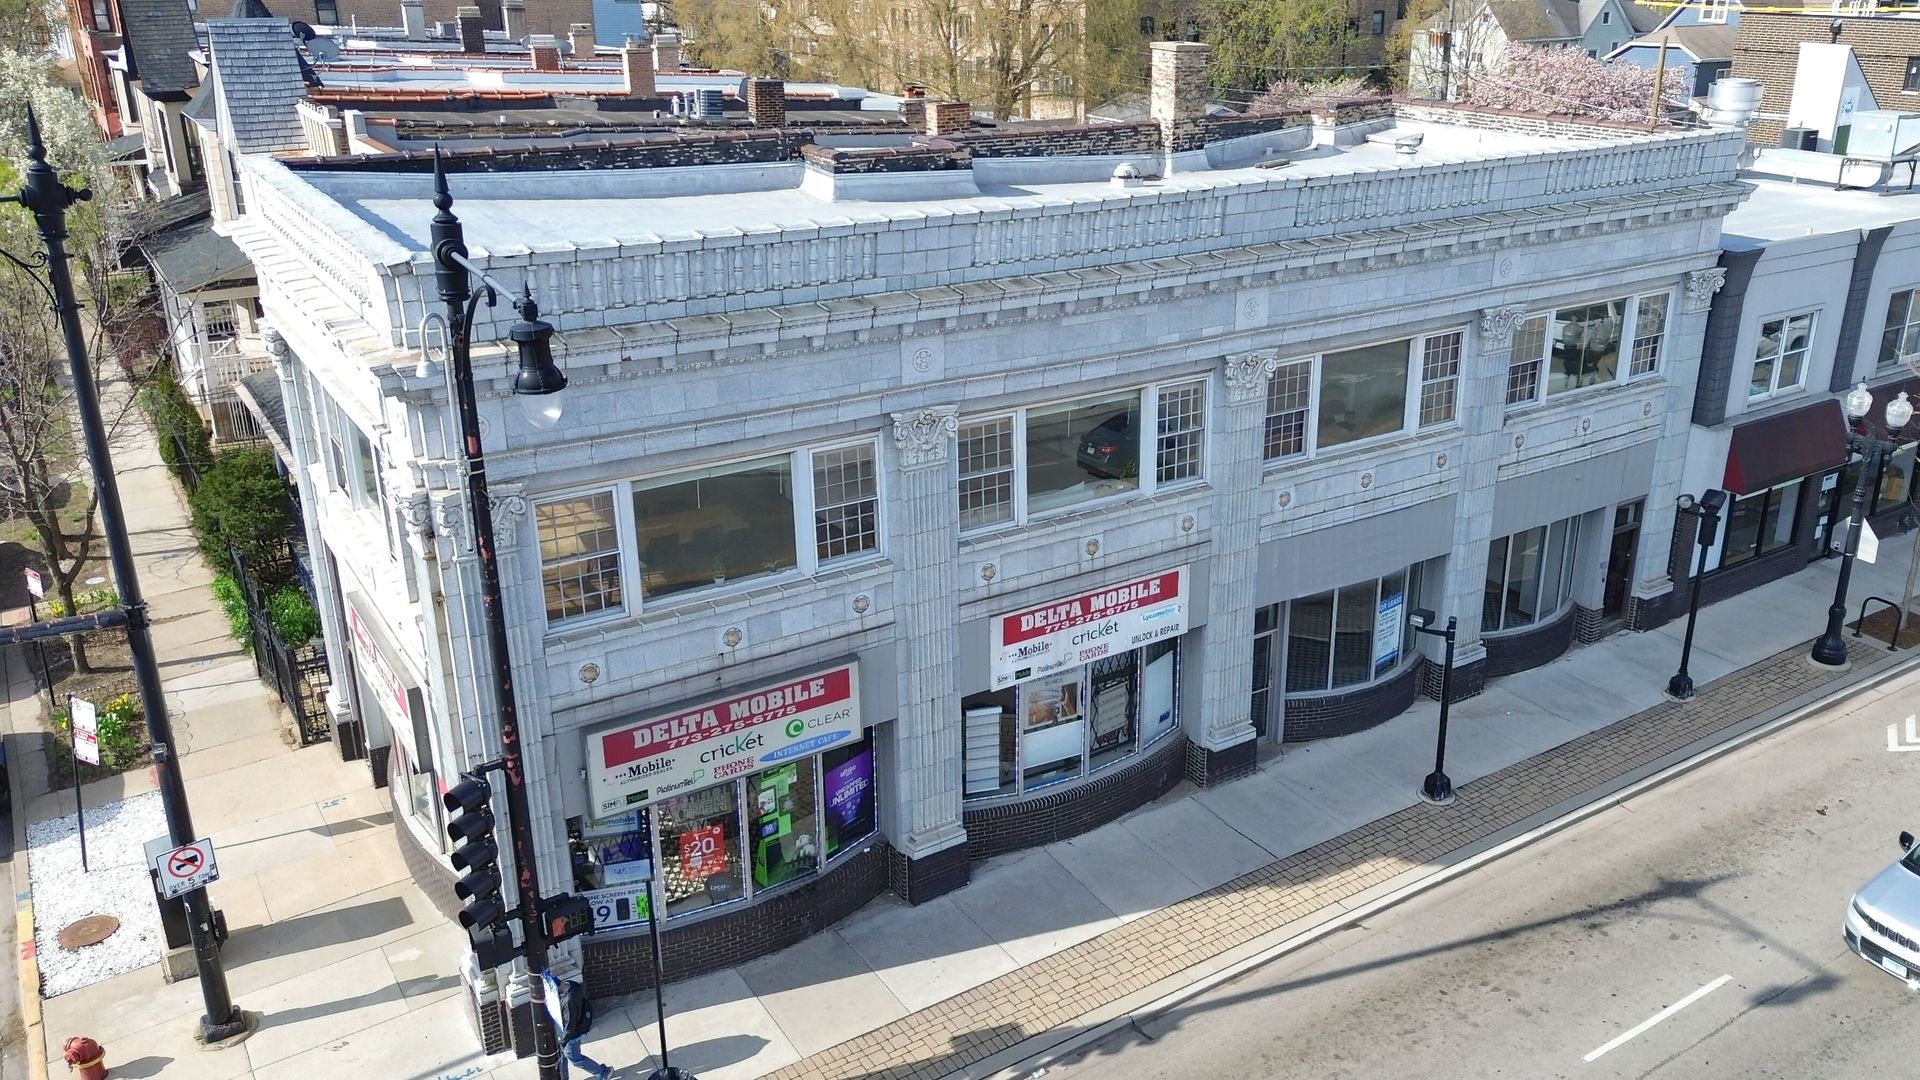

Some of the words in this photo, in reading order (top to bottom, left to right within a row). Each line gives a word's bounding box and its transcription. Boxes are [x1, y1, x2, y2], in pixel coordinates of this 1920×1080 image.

[1021, 602, 1083, 632] DELTA
[1090, 578, 1161, 612] MOBILE
[1044, 600, 1139, 633] 773-275-6775
[1072, 619, 1119, 646] cricket
[1131, 630, 1153, 645] UNLOCK
[1160, 623, 1179, 635] REPAIR
[1079, 643, 1109, 656] PHONE
[1079, 649, 1109, 661] CARDS
[633, 709, 718, 749] DELTA
[729, 677, 825, 720] MOBILE
[807, 710, 850, 729] CLEAR
[667, 705, 797, 749] 773-275-6775
[700, 731, 764, 763] cricket
[773, 738, 815, 759] INTERNET
[713, 756, 754, 774] PHONE
[713, 763, 754, 780] CARDS
[620, 772, 652, 785] AUTHORIZED
[653, 767, 673, 777] DEALER
[656, 777, 693, 795] PlatinumTel
[169, 881, 185, 891] OVER
[187, 877, 195, 885] 5
[601, 890, 626, 899] SCREEN
[627, 888, 646, 896] REPAI
[596, 905, 611, 922] 9
